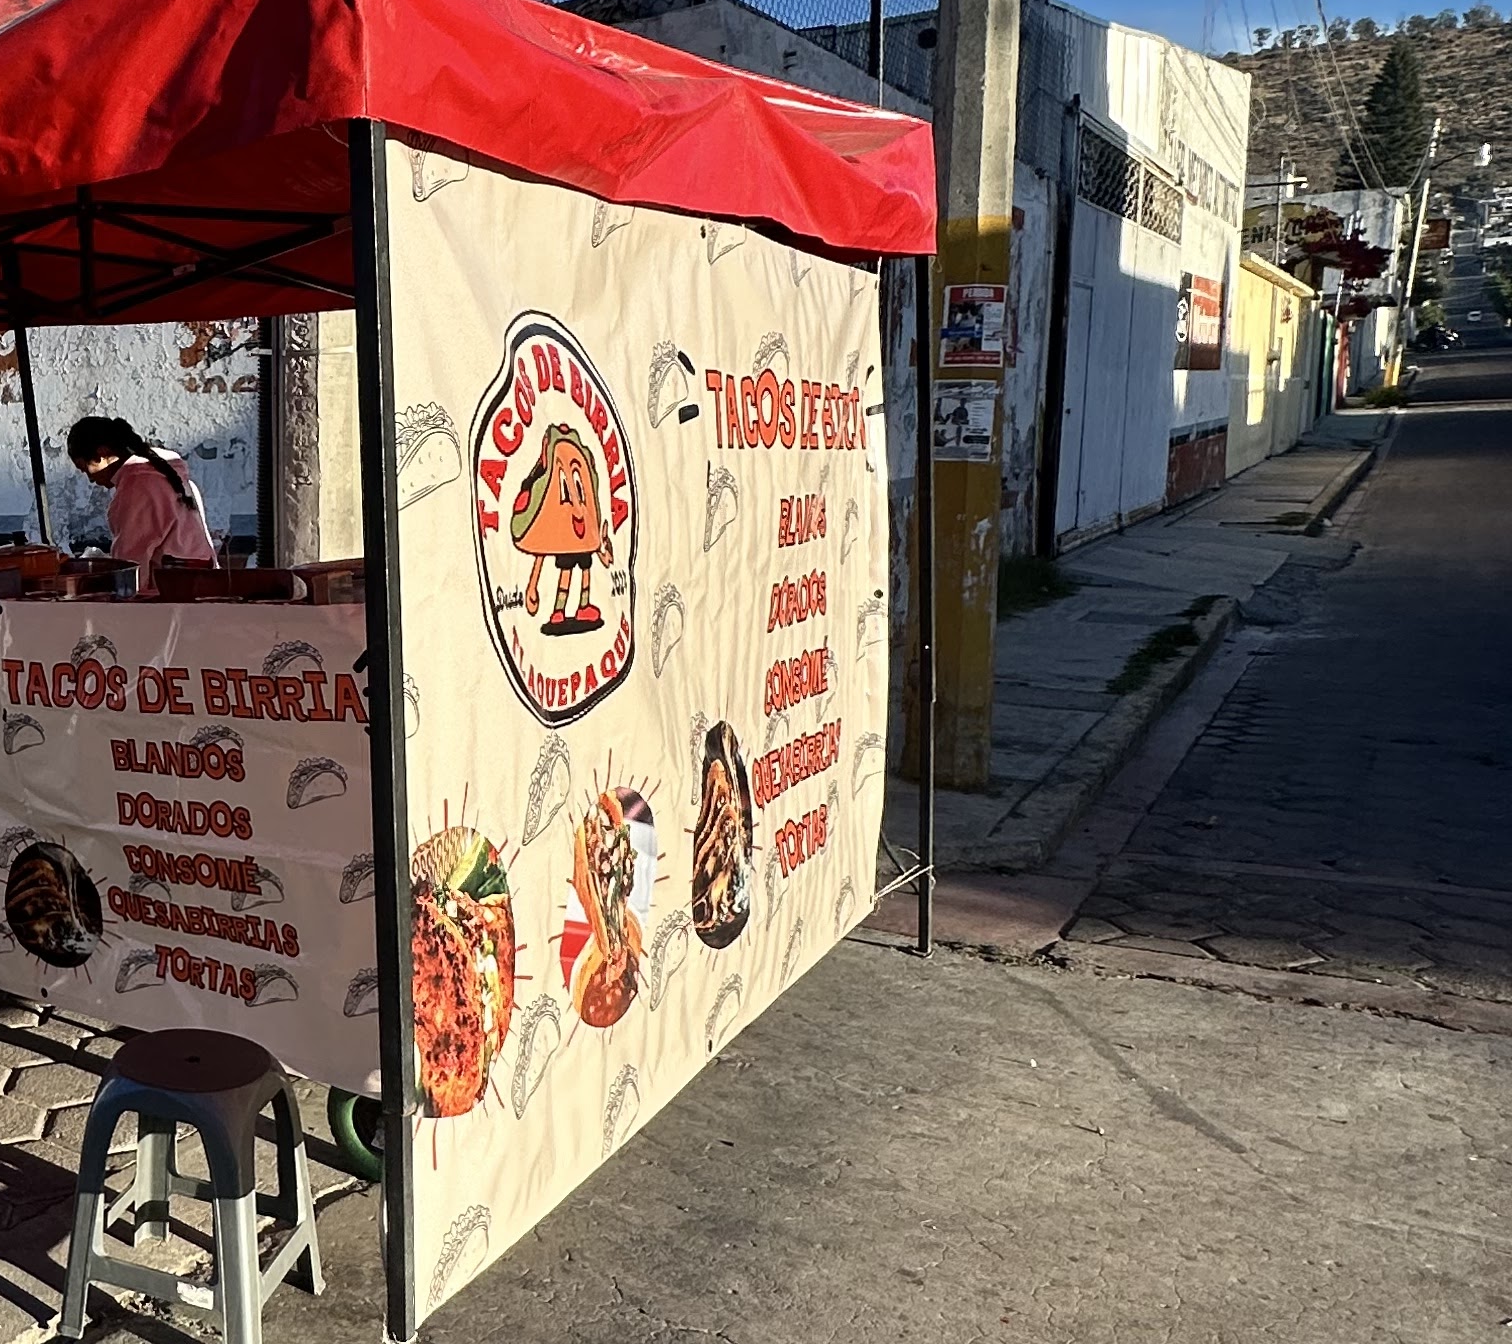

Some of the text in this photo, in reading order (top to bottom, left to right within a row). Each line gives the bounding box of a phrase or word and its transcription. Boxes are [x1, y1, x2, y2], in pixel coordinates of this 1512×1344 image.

[478, 357, 536, 539] TACOS
[531, 343, 566, 394] DE
[568, 357, 629, 535] BIRRIA
[705, 368, 796, 450] TACOS
[800, 379, 822, 450] DE
[2, 658, 369, 724] TACOS DE BIRRIA
[110, 739, 246, 782] BLANDOS
[117, 792, 253, 840] DORADOS
[775, 804, 827, 879] TORTAS
[123, 844, 262, 896] CONSOMÉ
[107, 886, 300, 958] QUESABIRRIAS
[155, 944, 257, 1001] TORTAS
